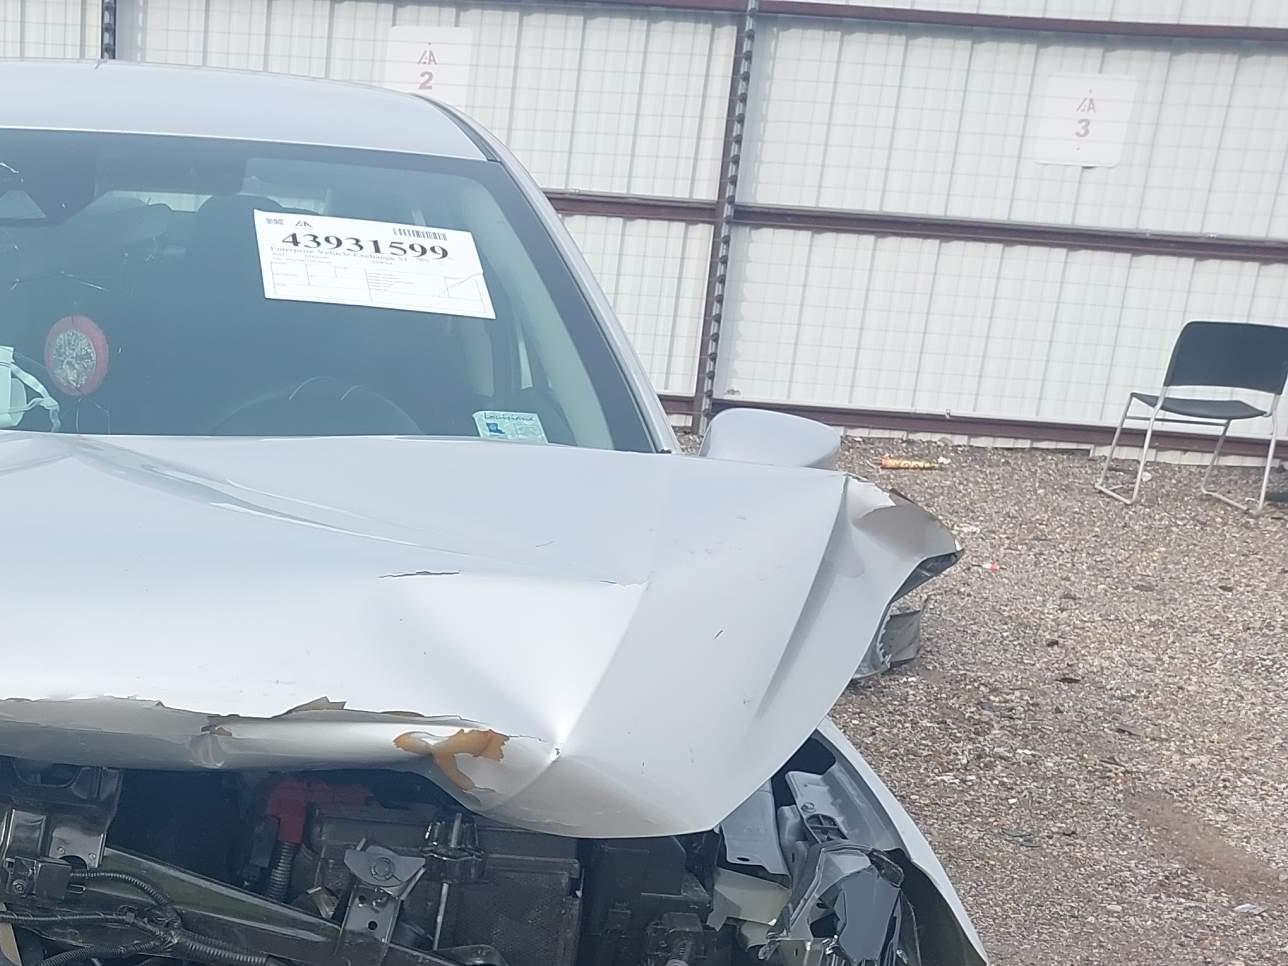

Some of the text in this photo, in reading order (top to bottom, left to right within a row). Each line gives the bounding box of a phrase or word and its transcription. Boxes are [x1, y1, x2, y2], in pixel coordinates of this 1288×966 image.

[418, 71, 433, 90] 2
[1075, 118, 1090, 138] 3
[282, 232, 449, 260] 43931599
